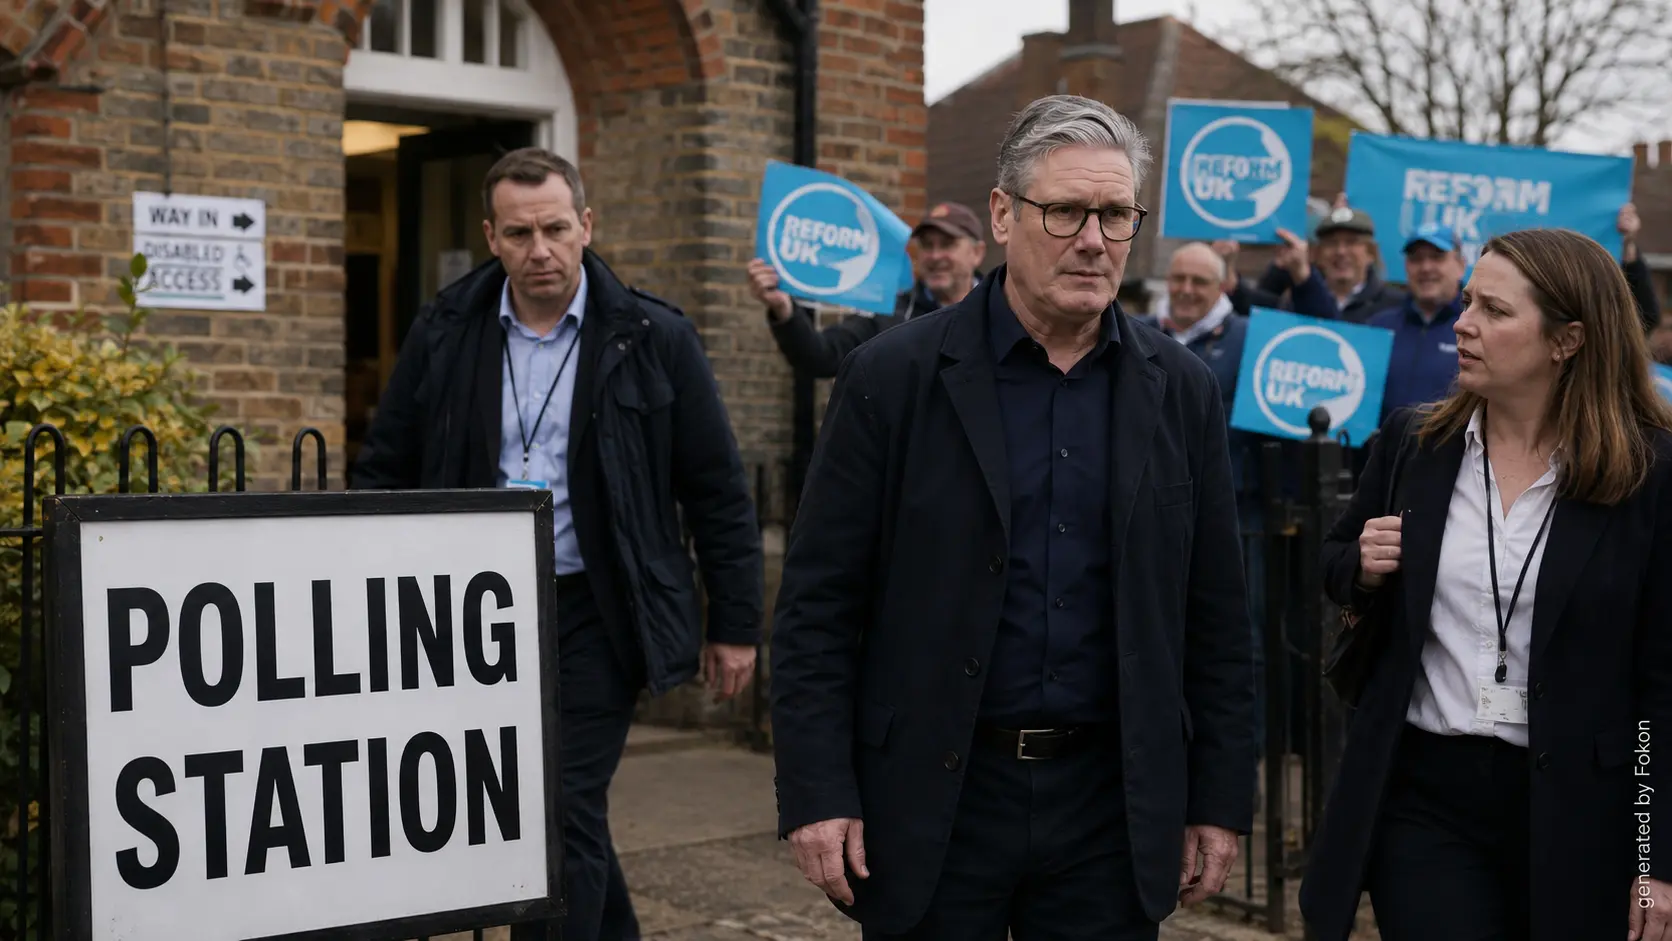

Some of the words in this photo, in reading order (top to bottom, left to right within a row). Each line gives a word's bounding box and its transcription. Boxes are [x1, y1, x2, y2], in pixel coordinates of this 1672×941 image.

[1193, 154, 1283, 181] REFORM
[1194, 172, 1235, 201] UK
[1403, 168, 1552, 215] REFORM
[148, 206, 191, 226] WAY
[198, 208, 218, 228] IN
[784, 214, 871, 252] REFORM
[779, 237, 821, 266] UK
[147, 267, 222, 291] ACCESS
[1269, 358, 1360, 393] REFORM
[1265, 381, 1306, 408] UK
[106, 570, 518, 713] POLLING
[115, 725, 522, 890] STATION
